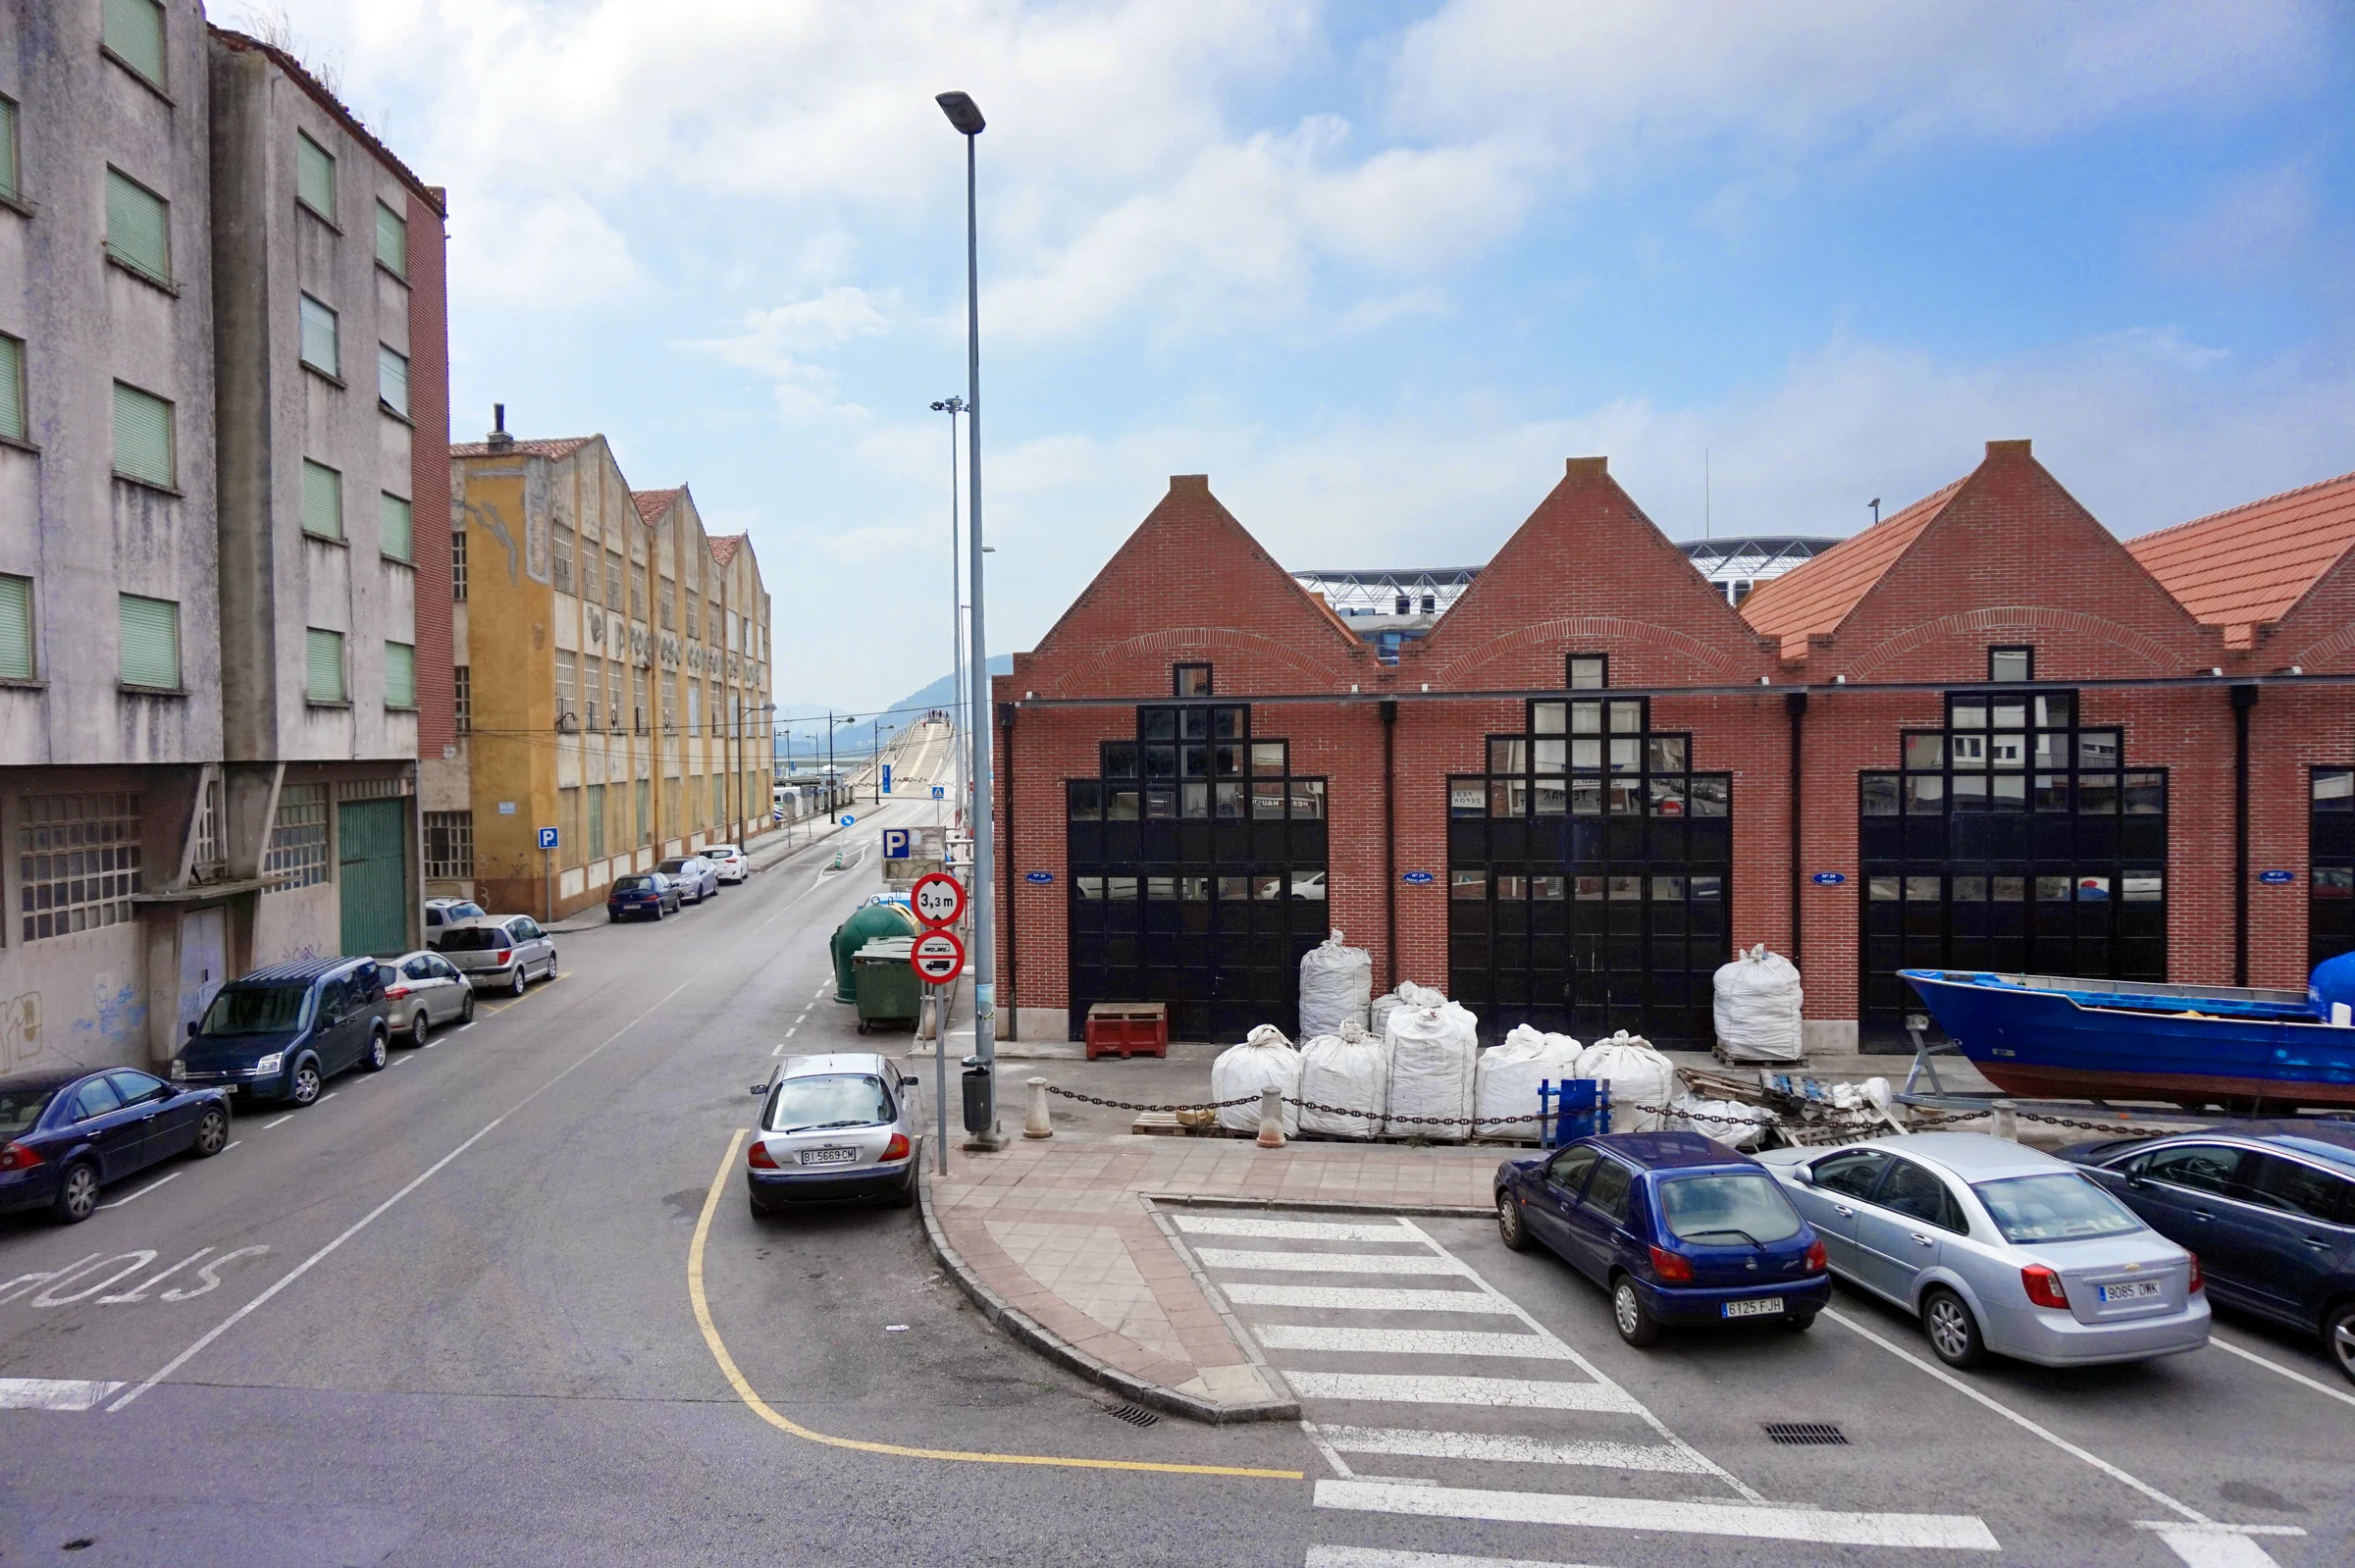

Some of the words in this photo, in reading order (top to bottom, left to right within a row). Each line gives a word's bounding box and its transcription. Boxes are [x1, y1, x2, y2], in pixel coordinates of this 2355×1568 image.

[543, 830, 554, 846] P
[886, 831, 907, 857] P
[920, 893, 941, 909] 3,3
[943, 897, 954, 908] m
[2108, 1284, 2135, 1300] 9085
[2139, 1282, 2160, 1296] DWK
[1729, 1301, 1756, 1315] 6125
